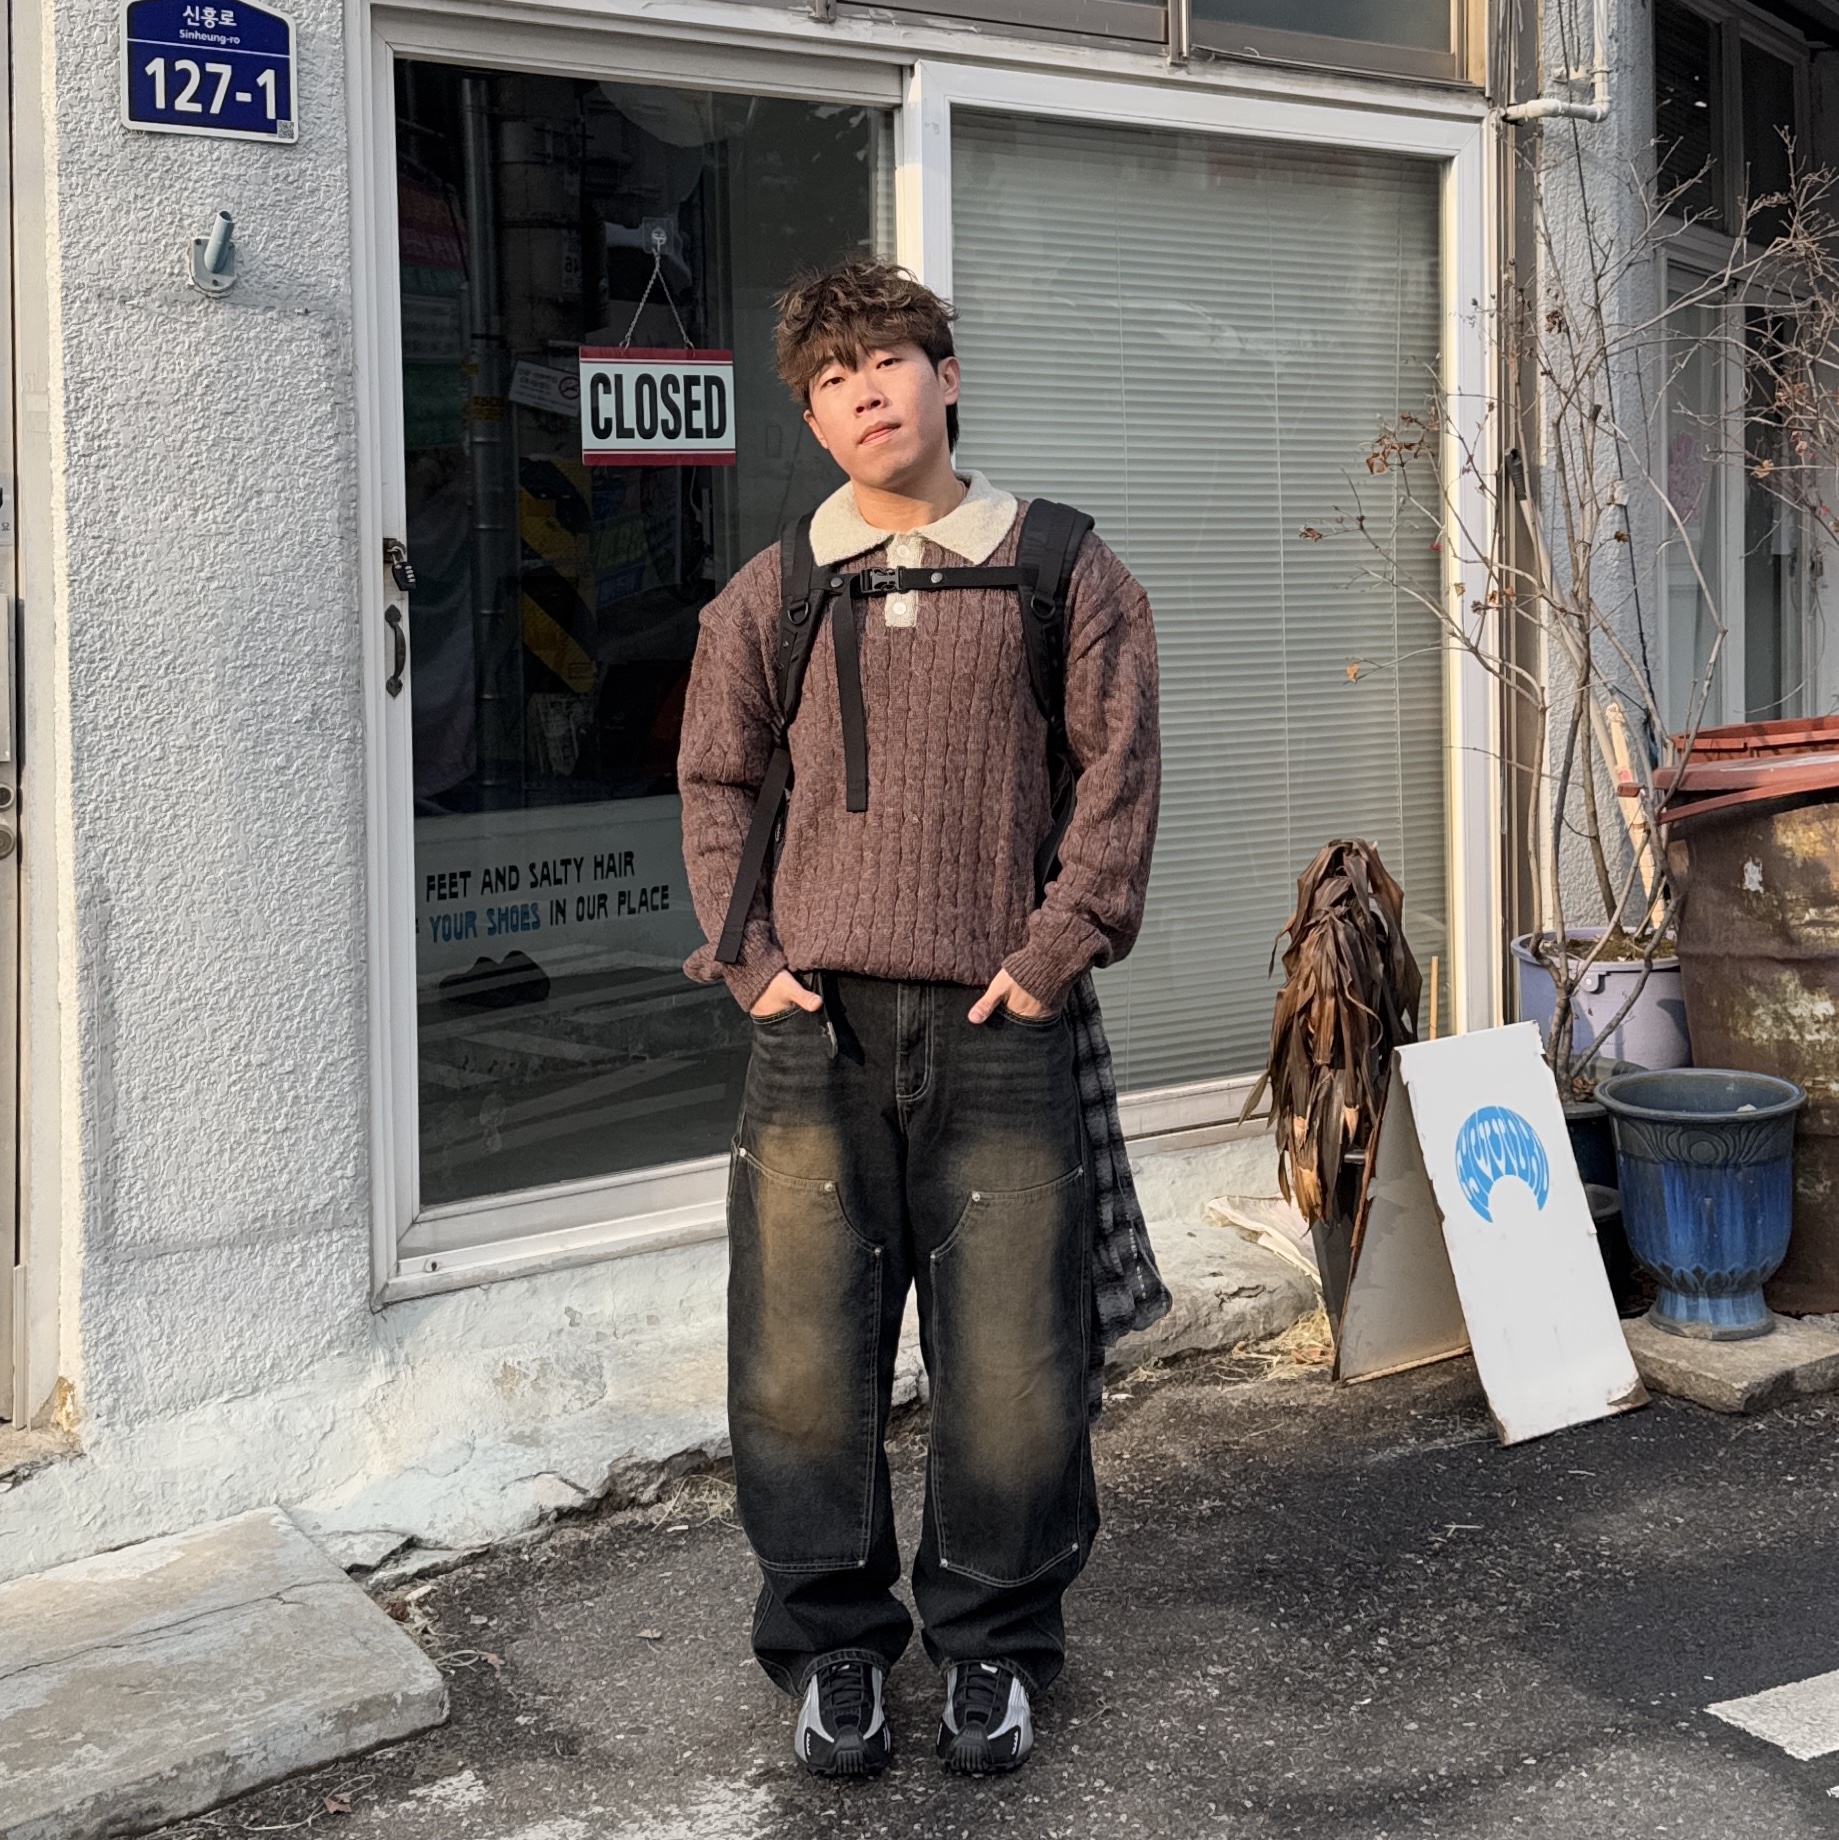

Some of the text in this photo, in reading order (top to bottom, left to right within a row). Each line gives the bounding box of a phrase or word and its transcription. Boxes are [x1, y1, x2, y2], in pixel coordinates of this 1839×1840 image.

[179, 29, 241, 45] Sinheung-ro
[182, 5, 238, 29] 신흥로
[144, 57, 277, 120] 127-1
[590, 372, 727, 440] CLOSED
[426, 850, 635, 902] FEET AND SALTY HAIR
[429, 910, 478, 944] YOUR
[486, 902, 542, 937] SHOES
[549, 898, 567, 926] IN
[576, 892, 608, 922] OUR
[617, 884, 670, 918] PLACE
